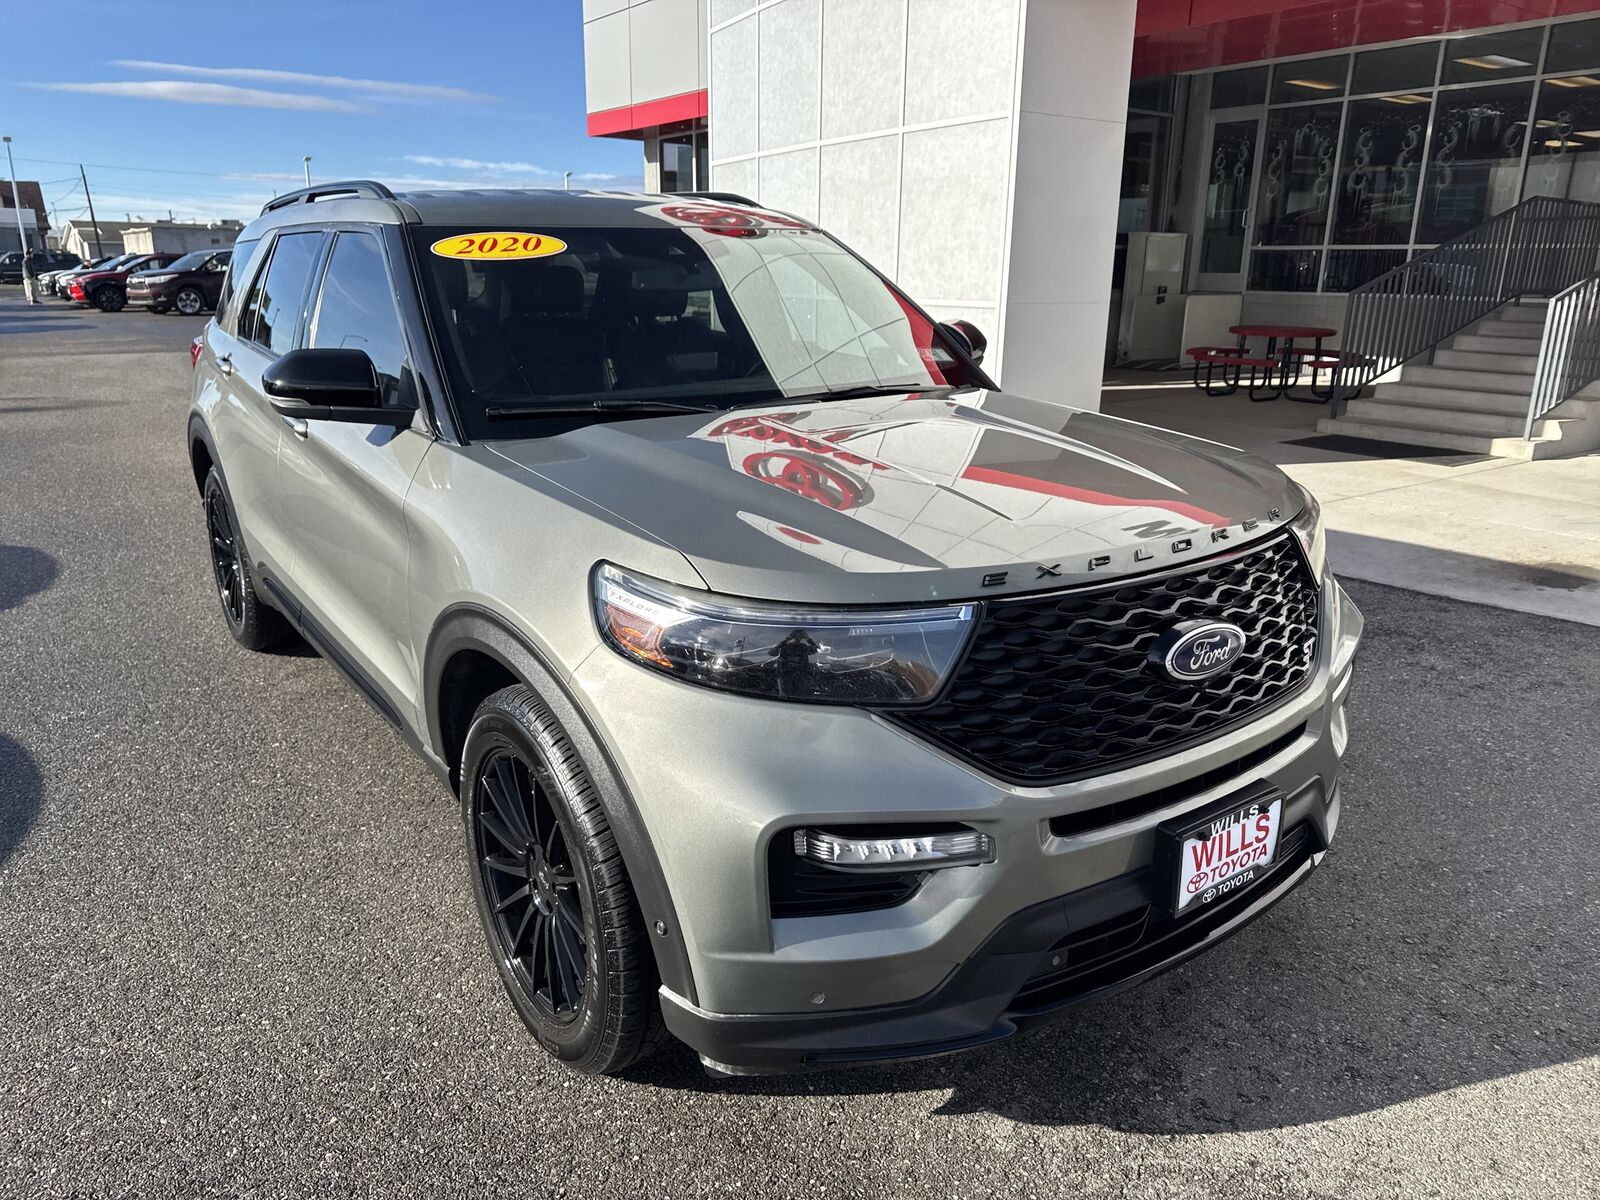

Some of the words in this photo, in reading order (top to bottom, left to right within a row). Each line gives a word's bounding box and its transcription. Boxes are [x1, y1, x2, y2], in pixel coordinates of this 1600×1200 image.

[455, 236, 542, 254] 2020
[981, 506, 1280, 587] EXPLORER
[1190, 634, 1231, 670] Ford
[1211, 804, 1260, 834] WILLS
[1191, 814, 1270, 872] WILLS
[1210, 843, 1267, 882] TOYOTA
[1218, 870, 1253, 895] TOYOTA
